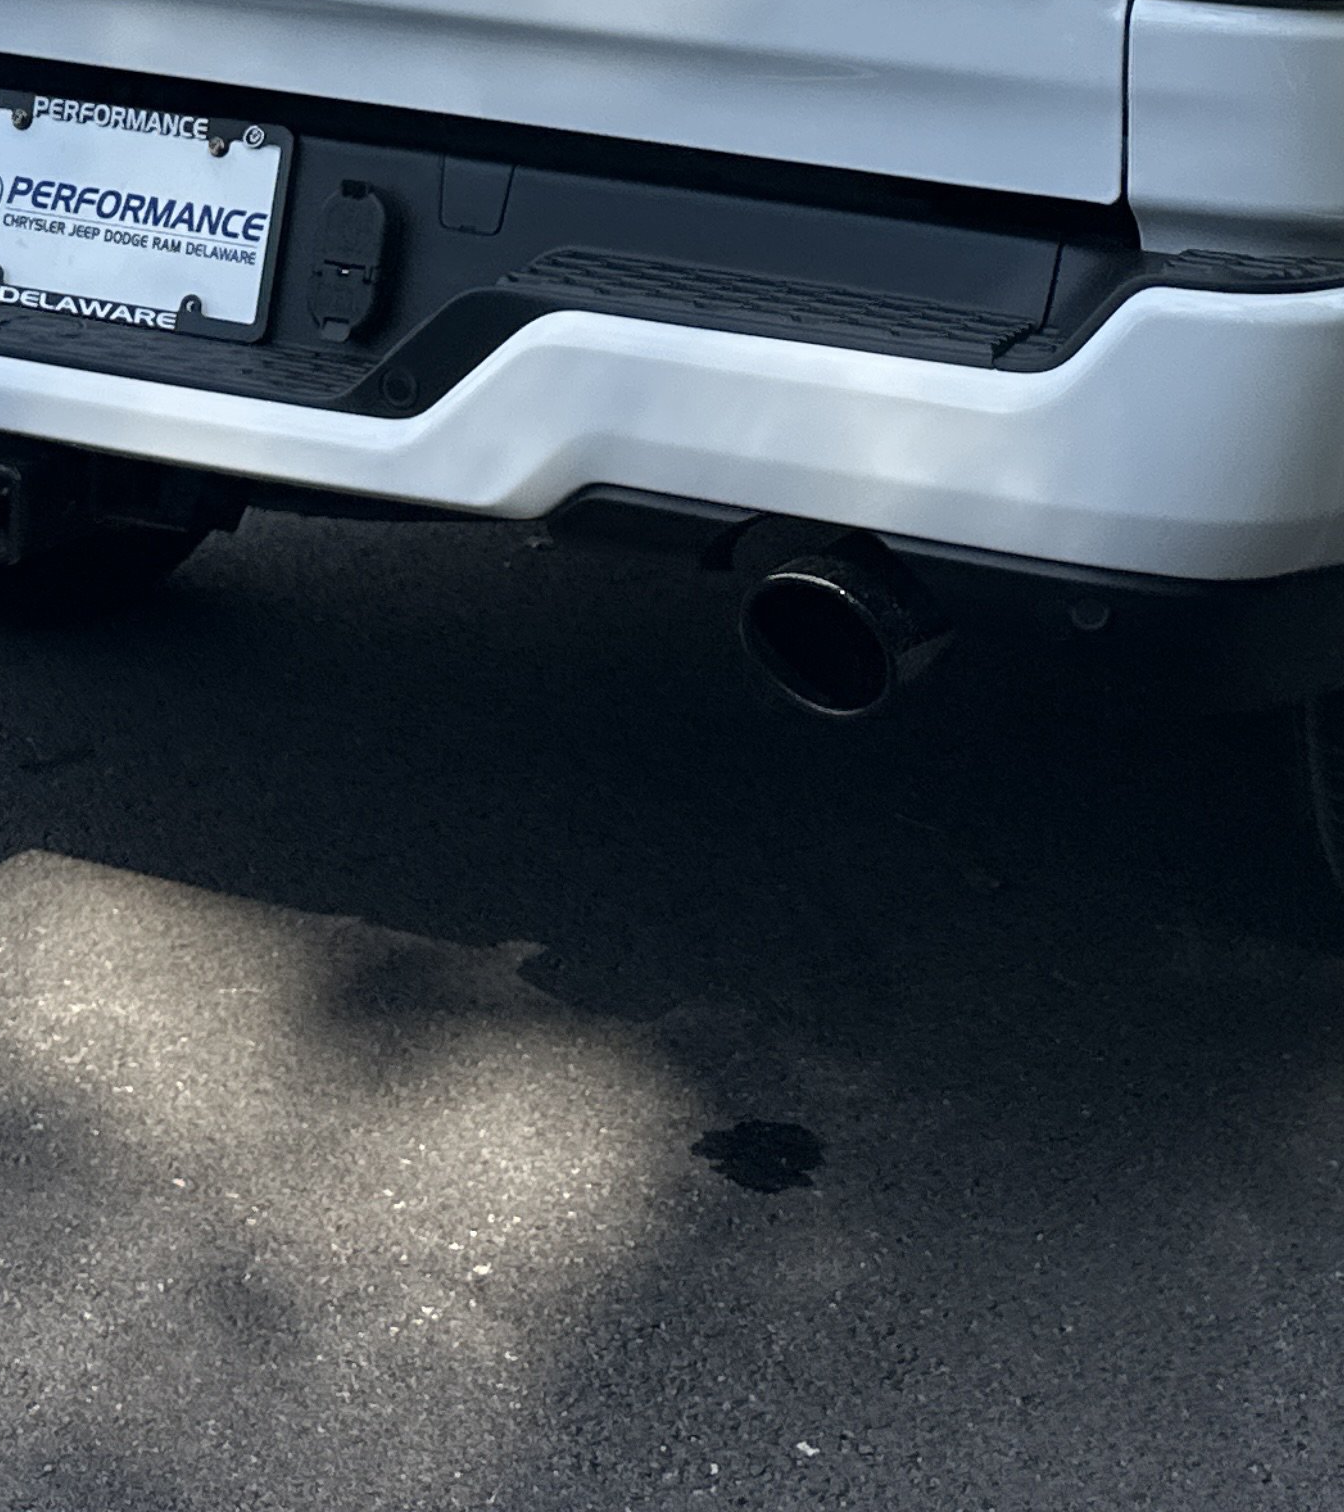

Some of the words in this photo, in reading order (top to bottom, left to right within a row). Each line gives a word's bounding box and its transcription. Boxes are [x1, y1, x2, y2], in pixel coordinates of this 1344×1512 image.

[33, 95, 210, 140] PERFORMANCE
[6, 175, 269, 242] PERFORMANCE
[3, 213, 66, 236] CHRYSLER
[68, 224, 101, 241] JEEP
[104, 230, 149, 249] DODGE
[151, 237, 182, 254] RAM
[185, 243, 257, 266] DELAWARE
